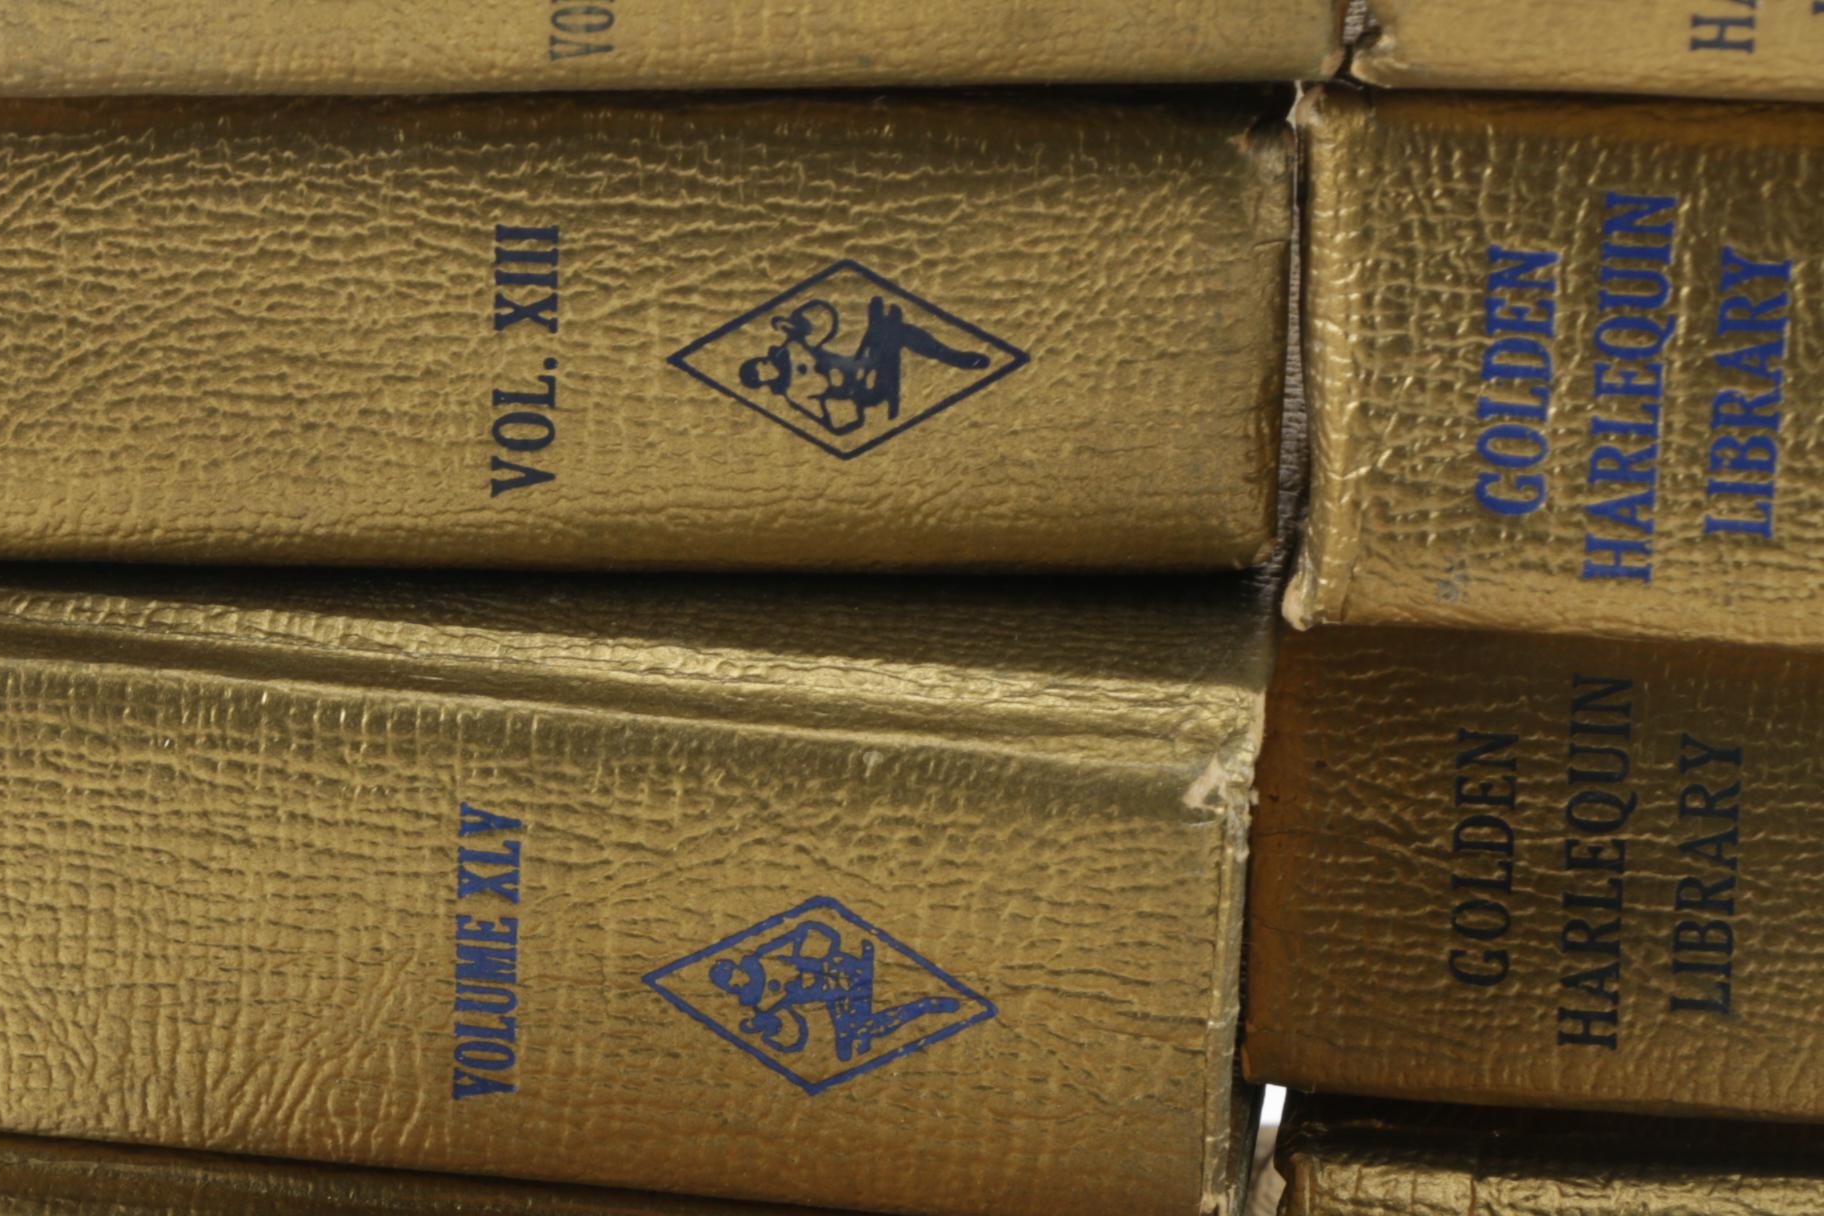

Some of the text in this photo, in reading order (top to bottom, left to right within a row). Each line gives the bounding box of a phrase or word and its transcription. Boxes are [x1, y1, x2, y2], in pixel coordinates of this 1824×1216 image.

[490, 225, 560, 496] VOL. XIII
[1475, 245, 1560, 516] GOLDEN
[1583, 191, 1678, 581] HARLEQUIN
[1705, 247, 1793, 538] LIBRARY
[1446, 727, 1518, 987] GOLDEN
[1554, 672, 1639, 1048] HARLEQUIN
[1669, 732, 1745, 1016] LIBRARY
[453, 915, 519, 1099] VOLUME
